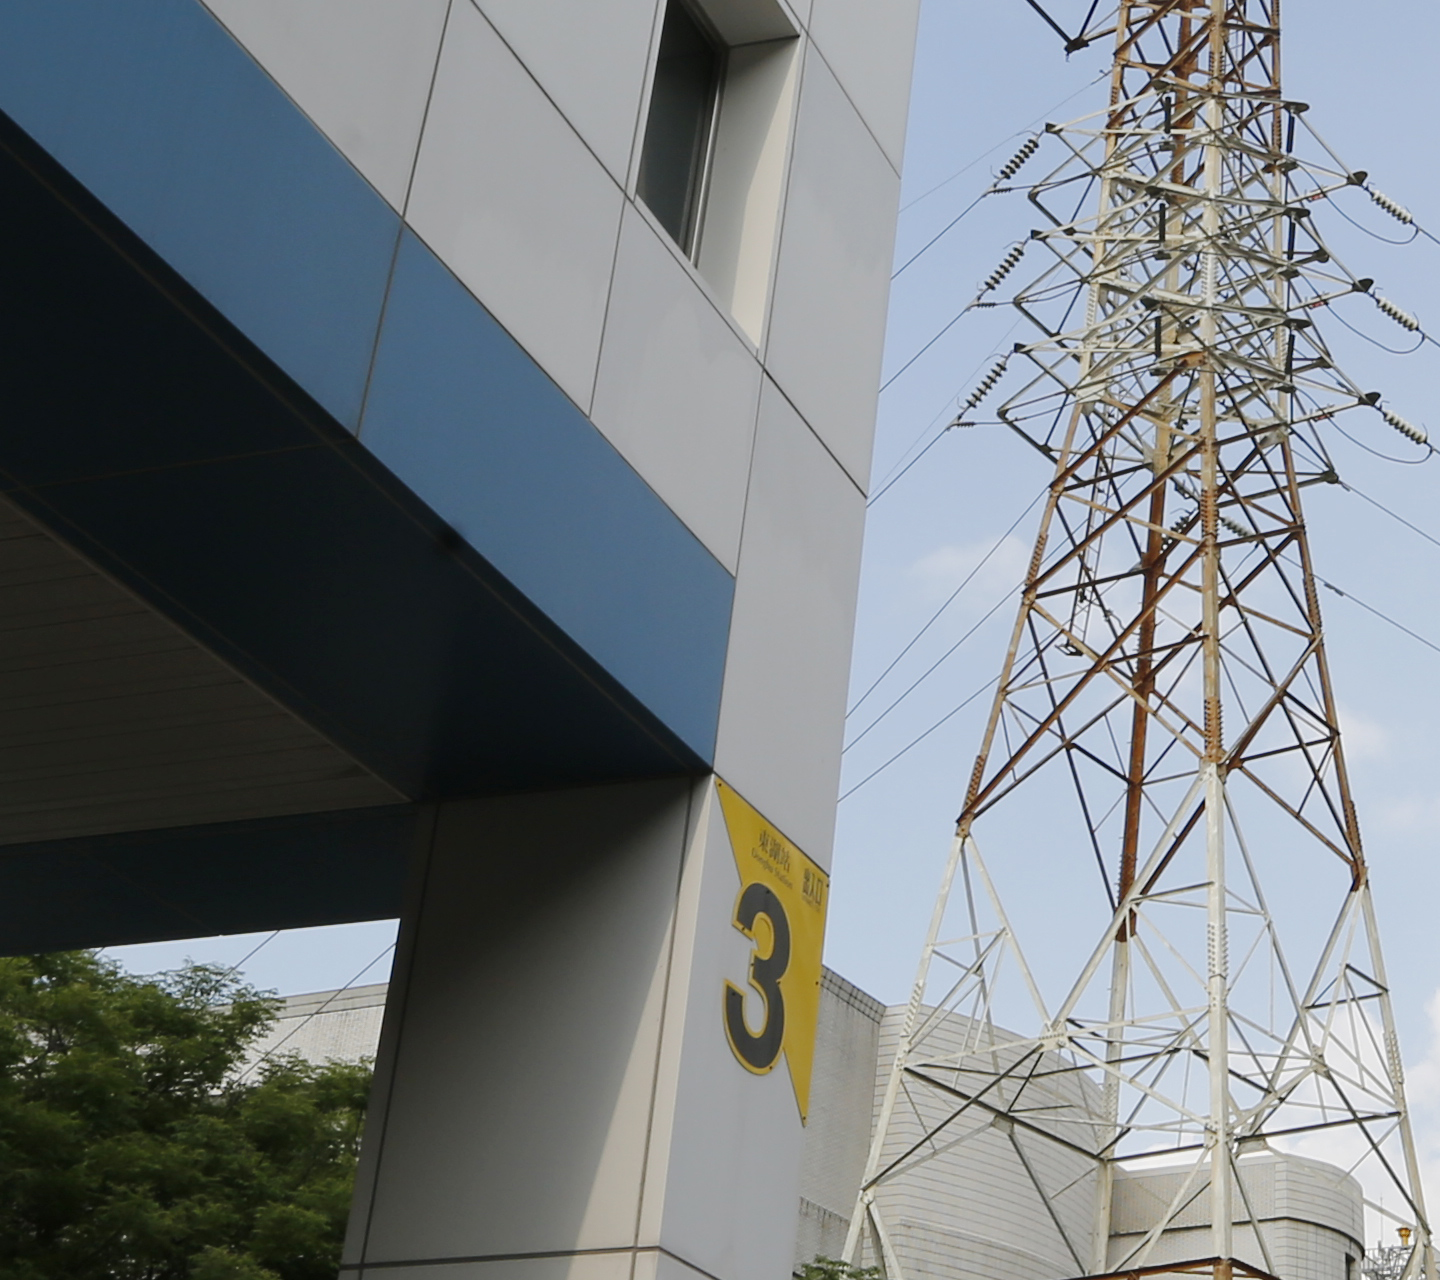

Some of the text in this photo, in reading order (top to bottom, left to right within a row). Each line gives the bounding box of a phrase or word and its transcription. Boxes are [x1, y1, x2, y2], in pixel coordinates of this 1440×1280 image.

[803, 868, 823, 907] 出入口
[725, 882, 790, 1069] 3
